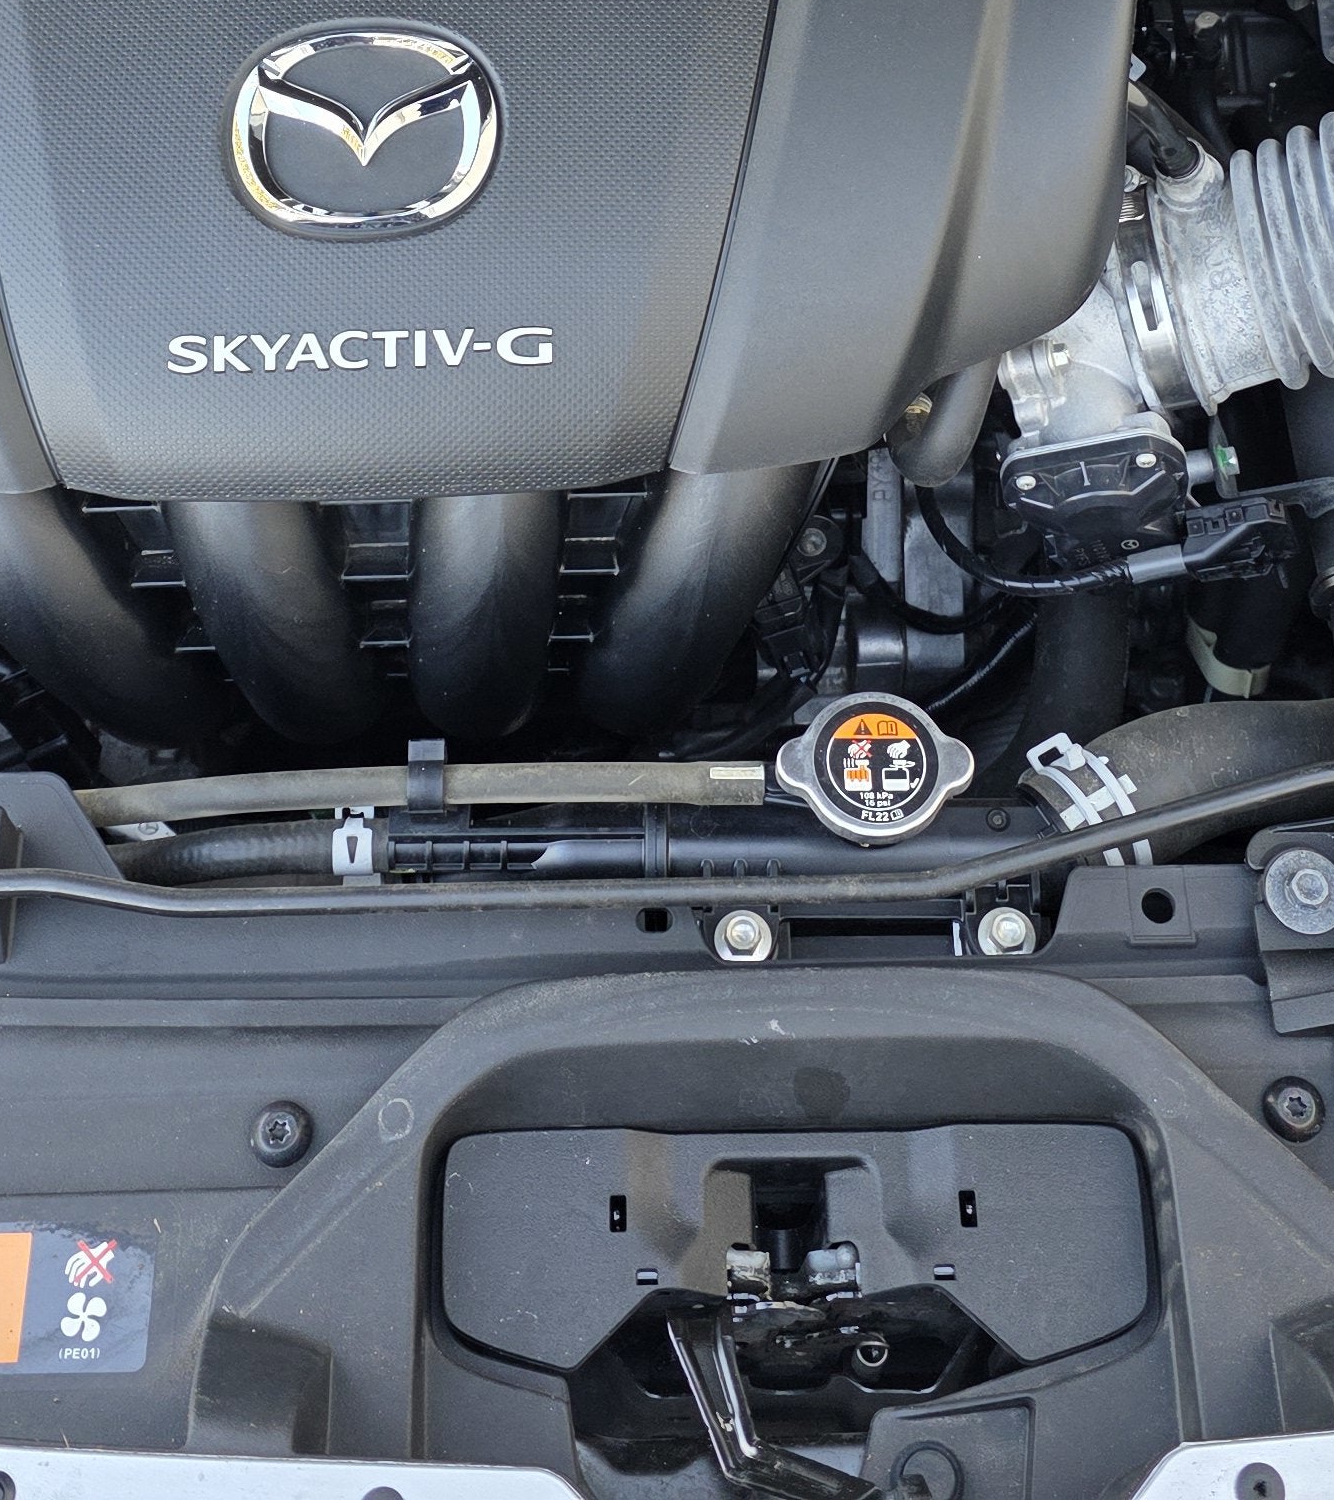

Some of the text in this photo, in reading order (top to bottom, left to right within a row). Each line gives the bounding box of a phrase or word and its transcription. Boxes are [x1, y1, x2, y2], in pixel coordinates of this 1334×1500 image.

[167, 327, 553, 373] SKYACTIV-G
[861, 810, 889, 822] FL22
[58, 1347, 100, 1360] (PE01)
